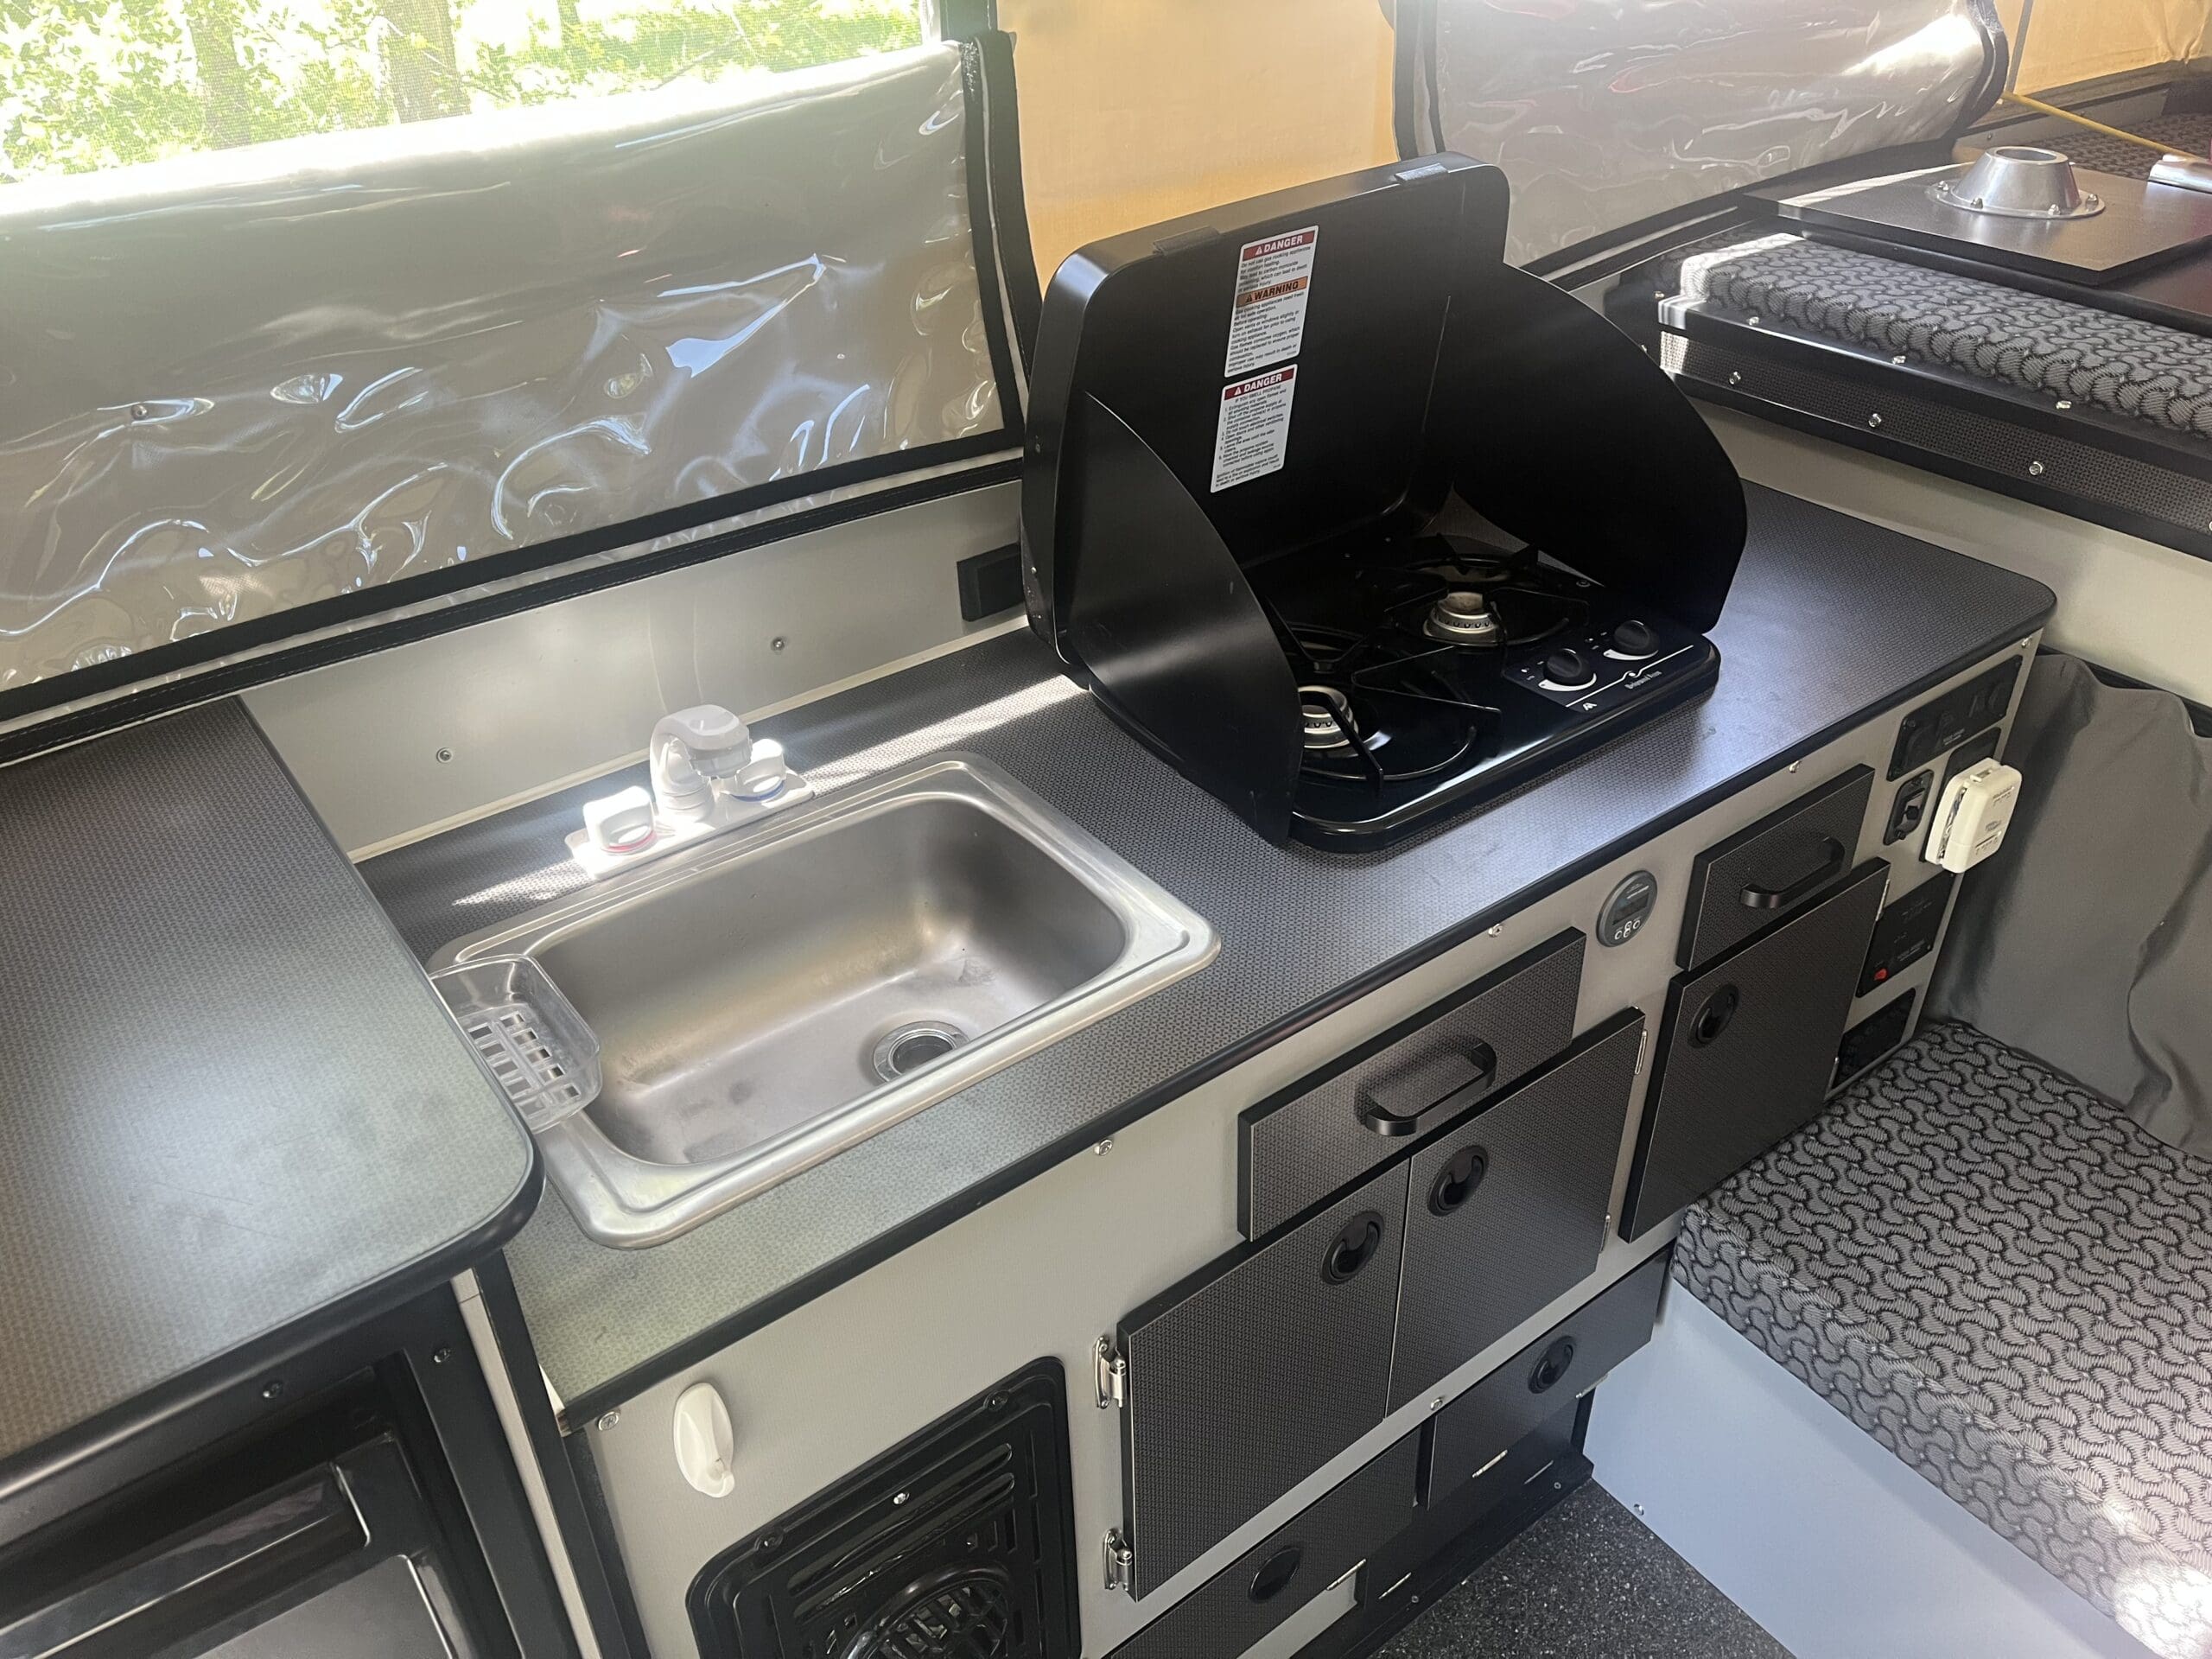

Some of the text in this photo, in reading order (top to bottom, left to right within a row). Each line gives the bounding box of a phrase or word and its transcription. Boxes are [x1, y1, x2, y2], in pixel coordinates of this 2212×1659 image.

[1263, 234, 1303, 252] DANGER
[1254, 280, 1298, 300] WARNING
[1243, 373, 1282, 392] DANGER
